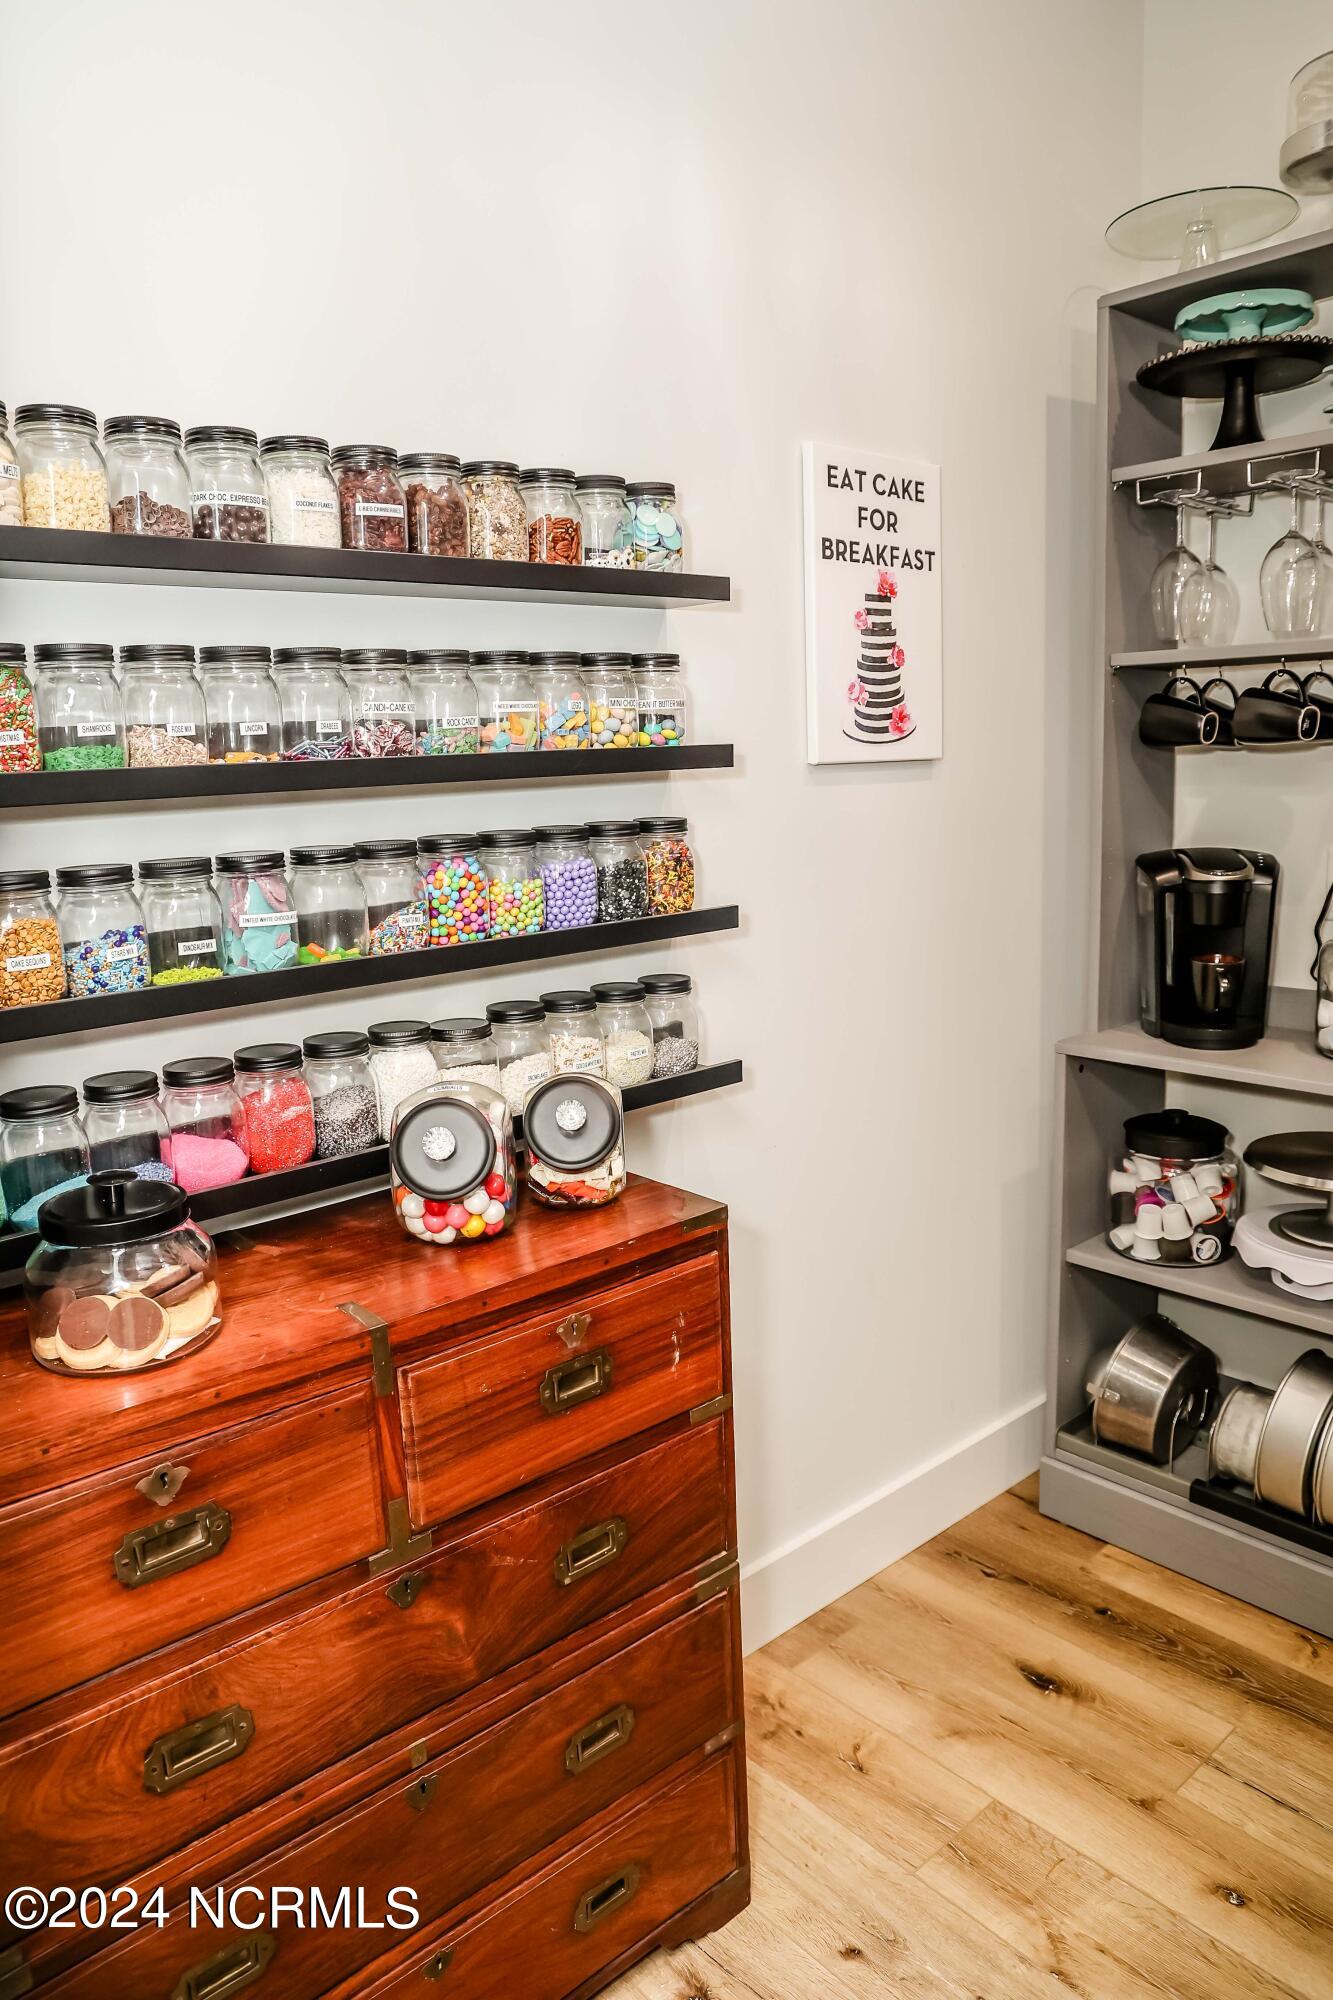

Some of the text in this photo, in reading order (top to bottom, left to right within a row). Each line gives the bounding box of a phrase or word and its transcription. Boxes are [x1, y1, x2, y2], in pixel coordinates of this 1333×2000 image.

[827, 464, 925, 503] EAT CAKE
[230, 494, 261, 504] EXPRESSO
[858, 506, 898, 533] FOR
[821, 537, 936, 572] BREAKFAST
[659, 700, 675, 708] BUTTER
[447, 717, 477, 726] ROCK CANDY
[82, 724, 112, 733] SHAMROCKS
[171, 725, 184, 733] ROSE
[245, 724, 264, 732] UNICORN
[183, 943, 205, 952] DINOSAUR
[11, 957, 47, 968] CAKE SEQUINS
